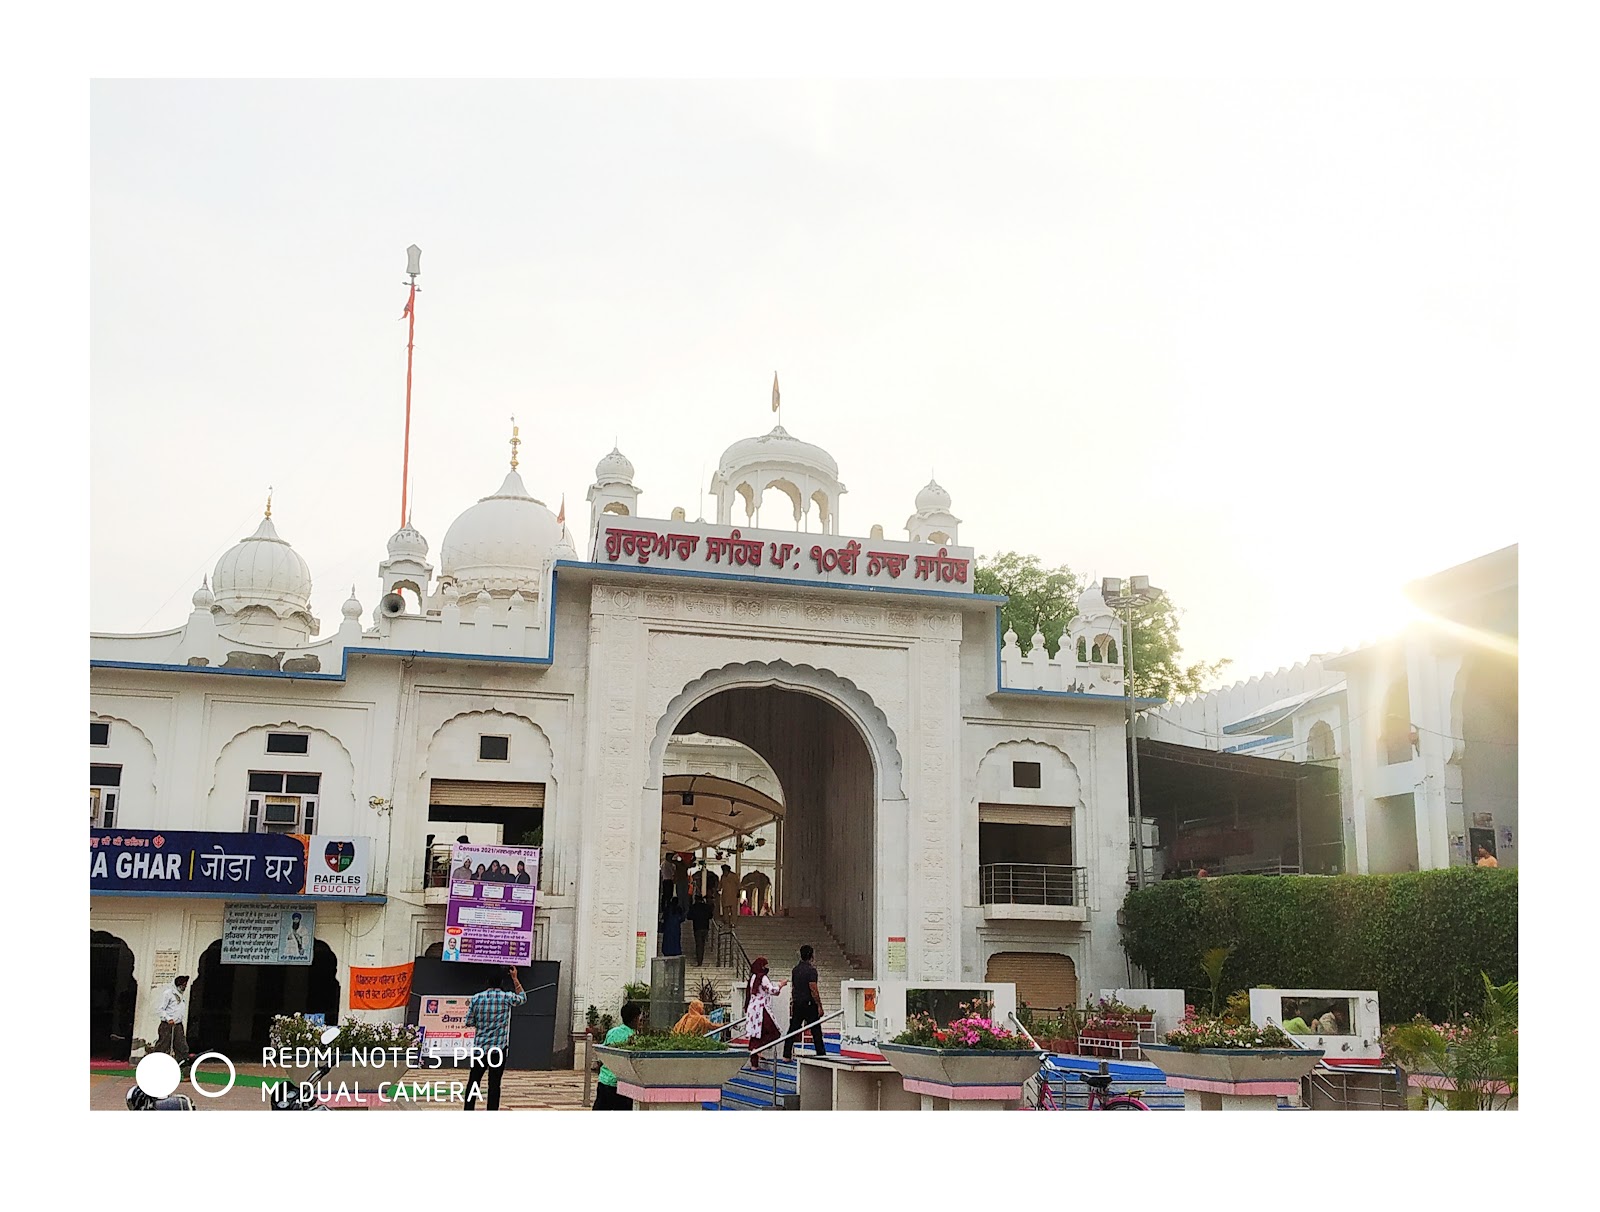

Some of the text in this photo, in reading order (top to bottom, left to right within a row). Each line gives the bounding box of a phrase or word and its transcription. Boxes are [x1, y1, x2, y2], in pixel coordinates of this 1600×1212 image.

[605, 527, 700, 564] ਗੁਰਦੁਆਰਾ
[706, 529, 764, 567] ਸਾਹਿਬ
[867, 551, 909, 578] ਨਾਢਾ
[915, 547, 970, 583] ਸਾਹਿਬ
[115, 852, 182, 880] GHAR
[264, 856, 298, 885] घर
[314, 874, 361, 884] RAFFLES
[313, 884, 360, 894] EDUCITY
[441, 1014, 462, 1023] टीका
